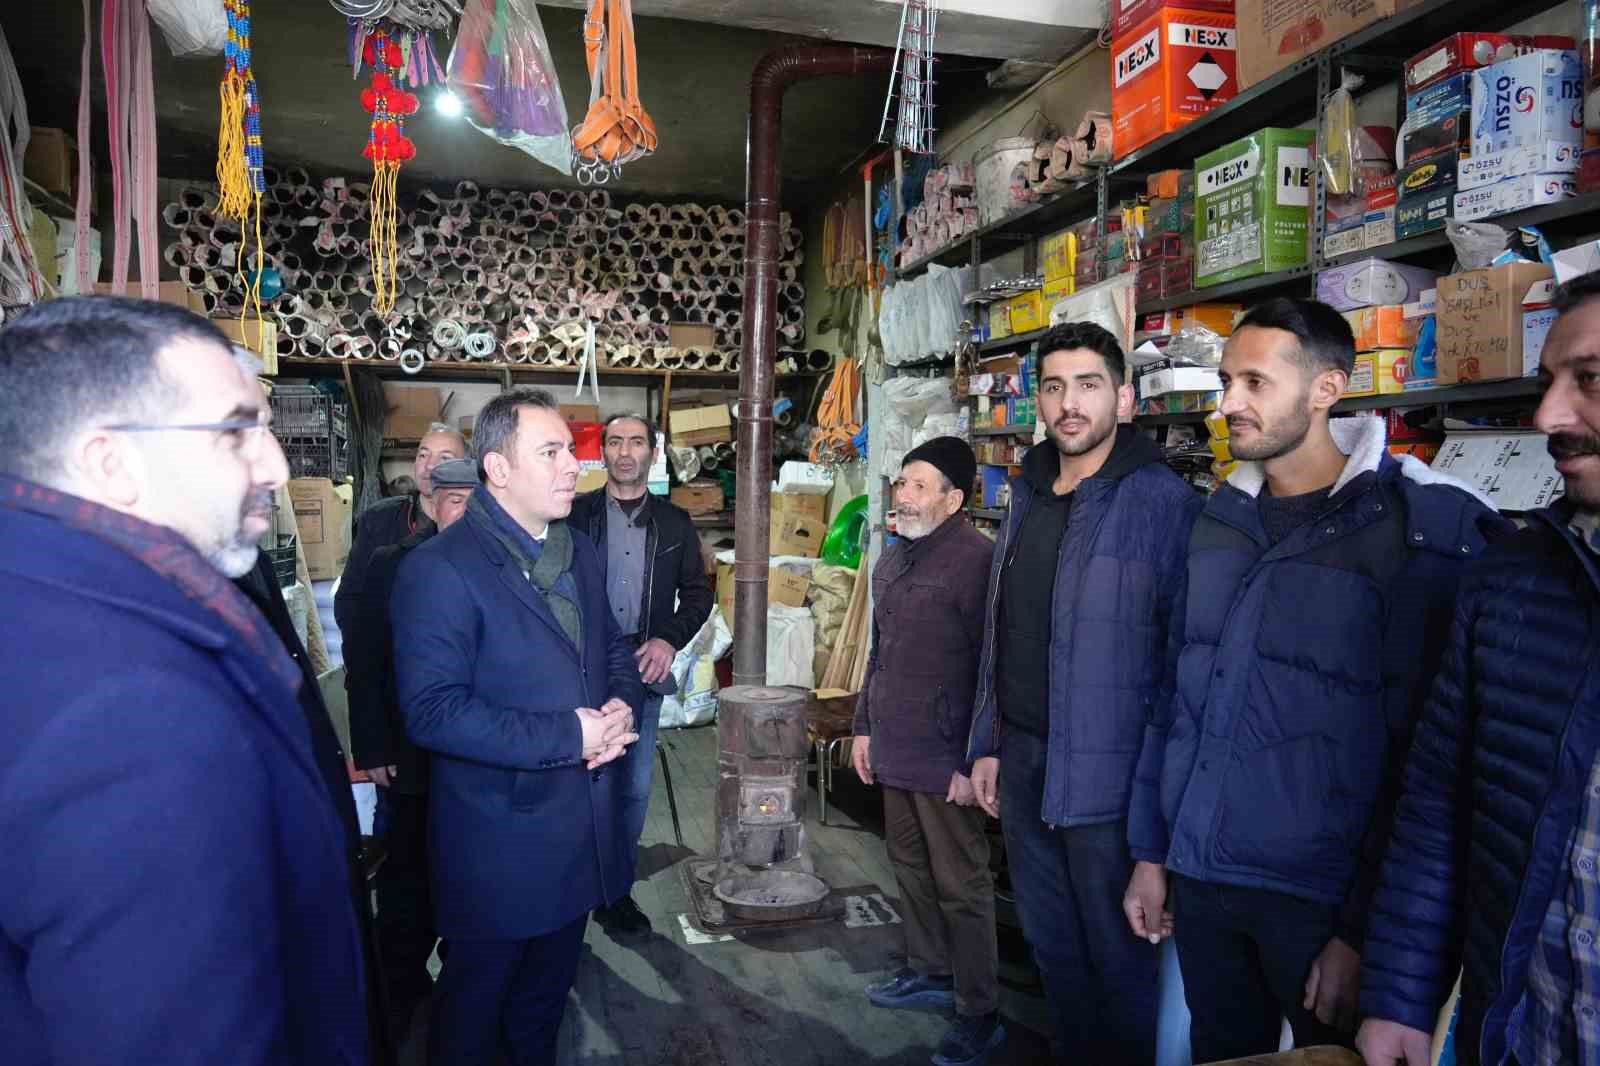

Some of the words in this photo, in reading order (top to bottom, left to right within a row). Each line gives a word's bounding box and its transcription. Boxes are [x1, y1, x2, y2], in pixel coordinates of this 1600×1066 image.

[1184, 28, 1228, 46] NEOX
[1119, 38, 1155, 79] NEOX
[1496, 76, 1517, 132] ÖZSU
[1215, 160, 1243, 186] NEOX
[1475, 157, 1502, 169] ÖZSU
[1468, 191, 1493, 203] ÖZSU
